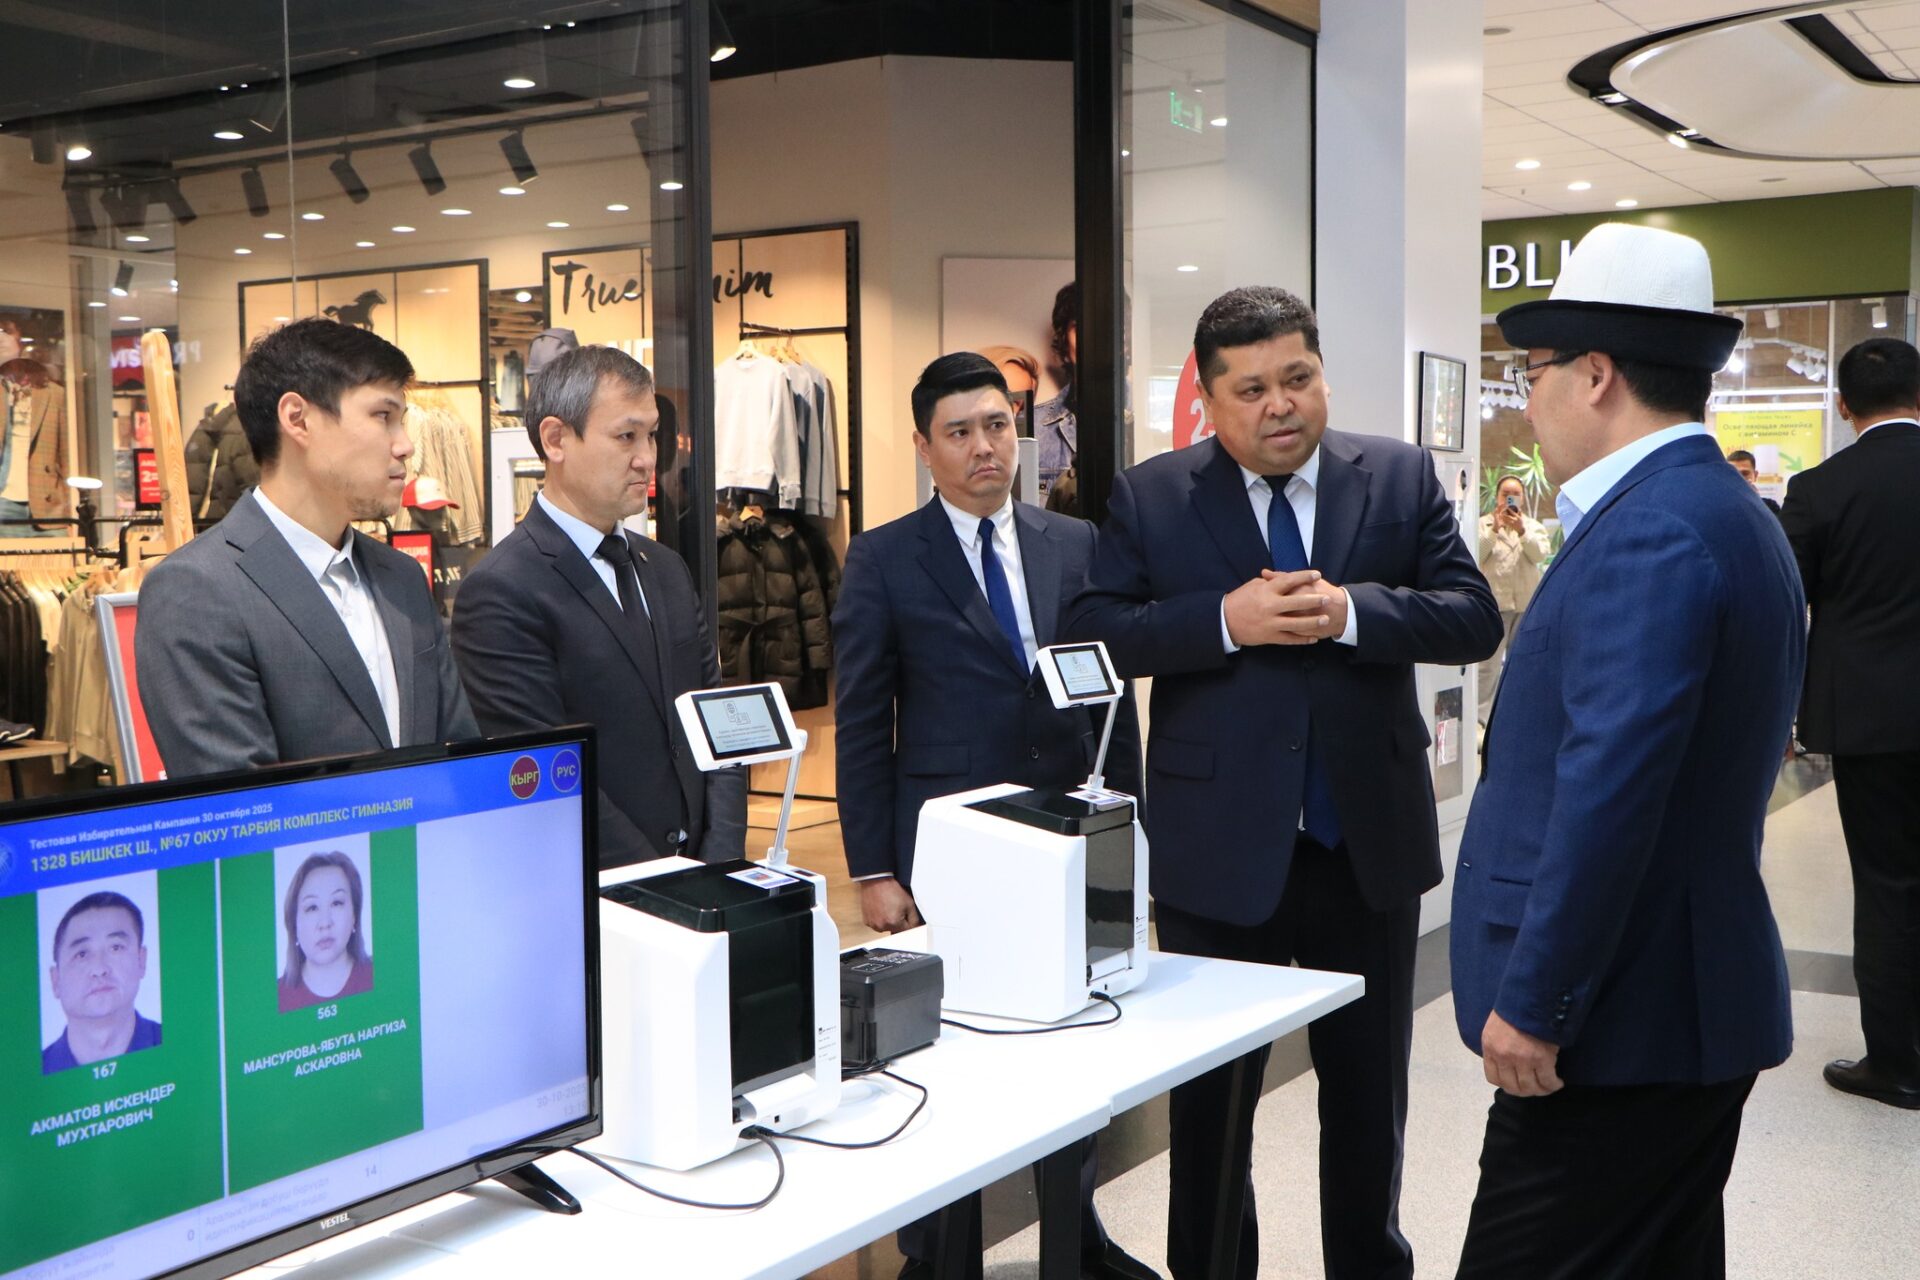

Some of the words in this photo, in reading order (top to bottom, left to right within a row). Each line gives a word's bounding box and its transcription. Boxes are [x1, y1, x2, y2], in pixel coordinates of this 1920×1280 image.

[552, 260, 643, 315] True
[511, 770, 539, 786] КЫРГ
[557, 765, 576, 779] РУС
[30, 835, 77, 850] Тестовая
[79, 824, 152, 843] Избирательная
[154, 816, 200, 830] Кампания
[202, 812, 214, 823] 30
[215, 807, 250, 821] октября
[252, 803, 273, 815] 2025
[31, 854, 67, 872] 1328
[71, 843, 133, 866] БИШКЕК
[136, 840, 158, 855] Ш.,
[160, 833, 190, 850] №67
[193, 827, 228, 844] ОКУУ
[231, 819, 281, 838] ТАРБИЯ
[284, 808, 350, 830] КОМПЛЕКС
[352, 798, 414, 818] ГИМНАЗИЯ
[317, 1004, 338, 1020] 563
[243, 1033, 356, 1075] МАНСУРОВА-ЯБУТА
[358, 1018, 407, 1042] НАРГИЗА
[92, 1062, 118, 1079] 167
[294, 1048, 362, 1077] АСКАРОВНА
[30, 1104, 101, 1136] АКМАТОВ
[103, 1083, 176, 1114] ИСКЕНДЕР
[56, 1107, 154, 1147] МУХТАРОВИЧ
[365, 1165, 377, 1178] 14
[320, 1212, 350, 1230] VESTEL
[187, 1229, 195, 1241] 0
